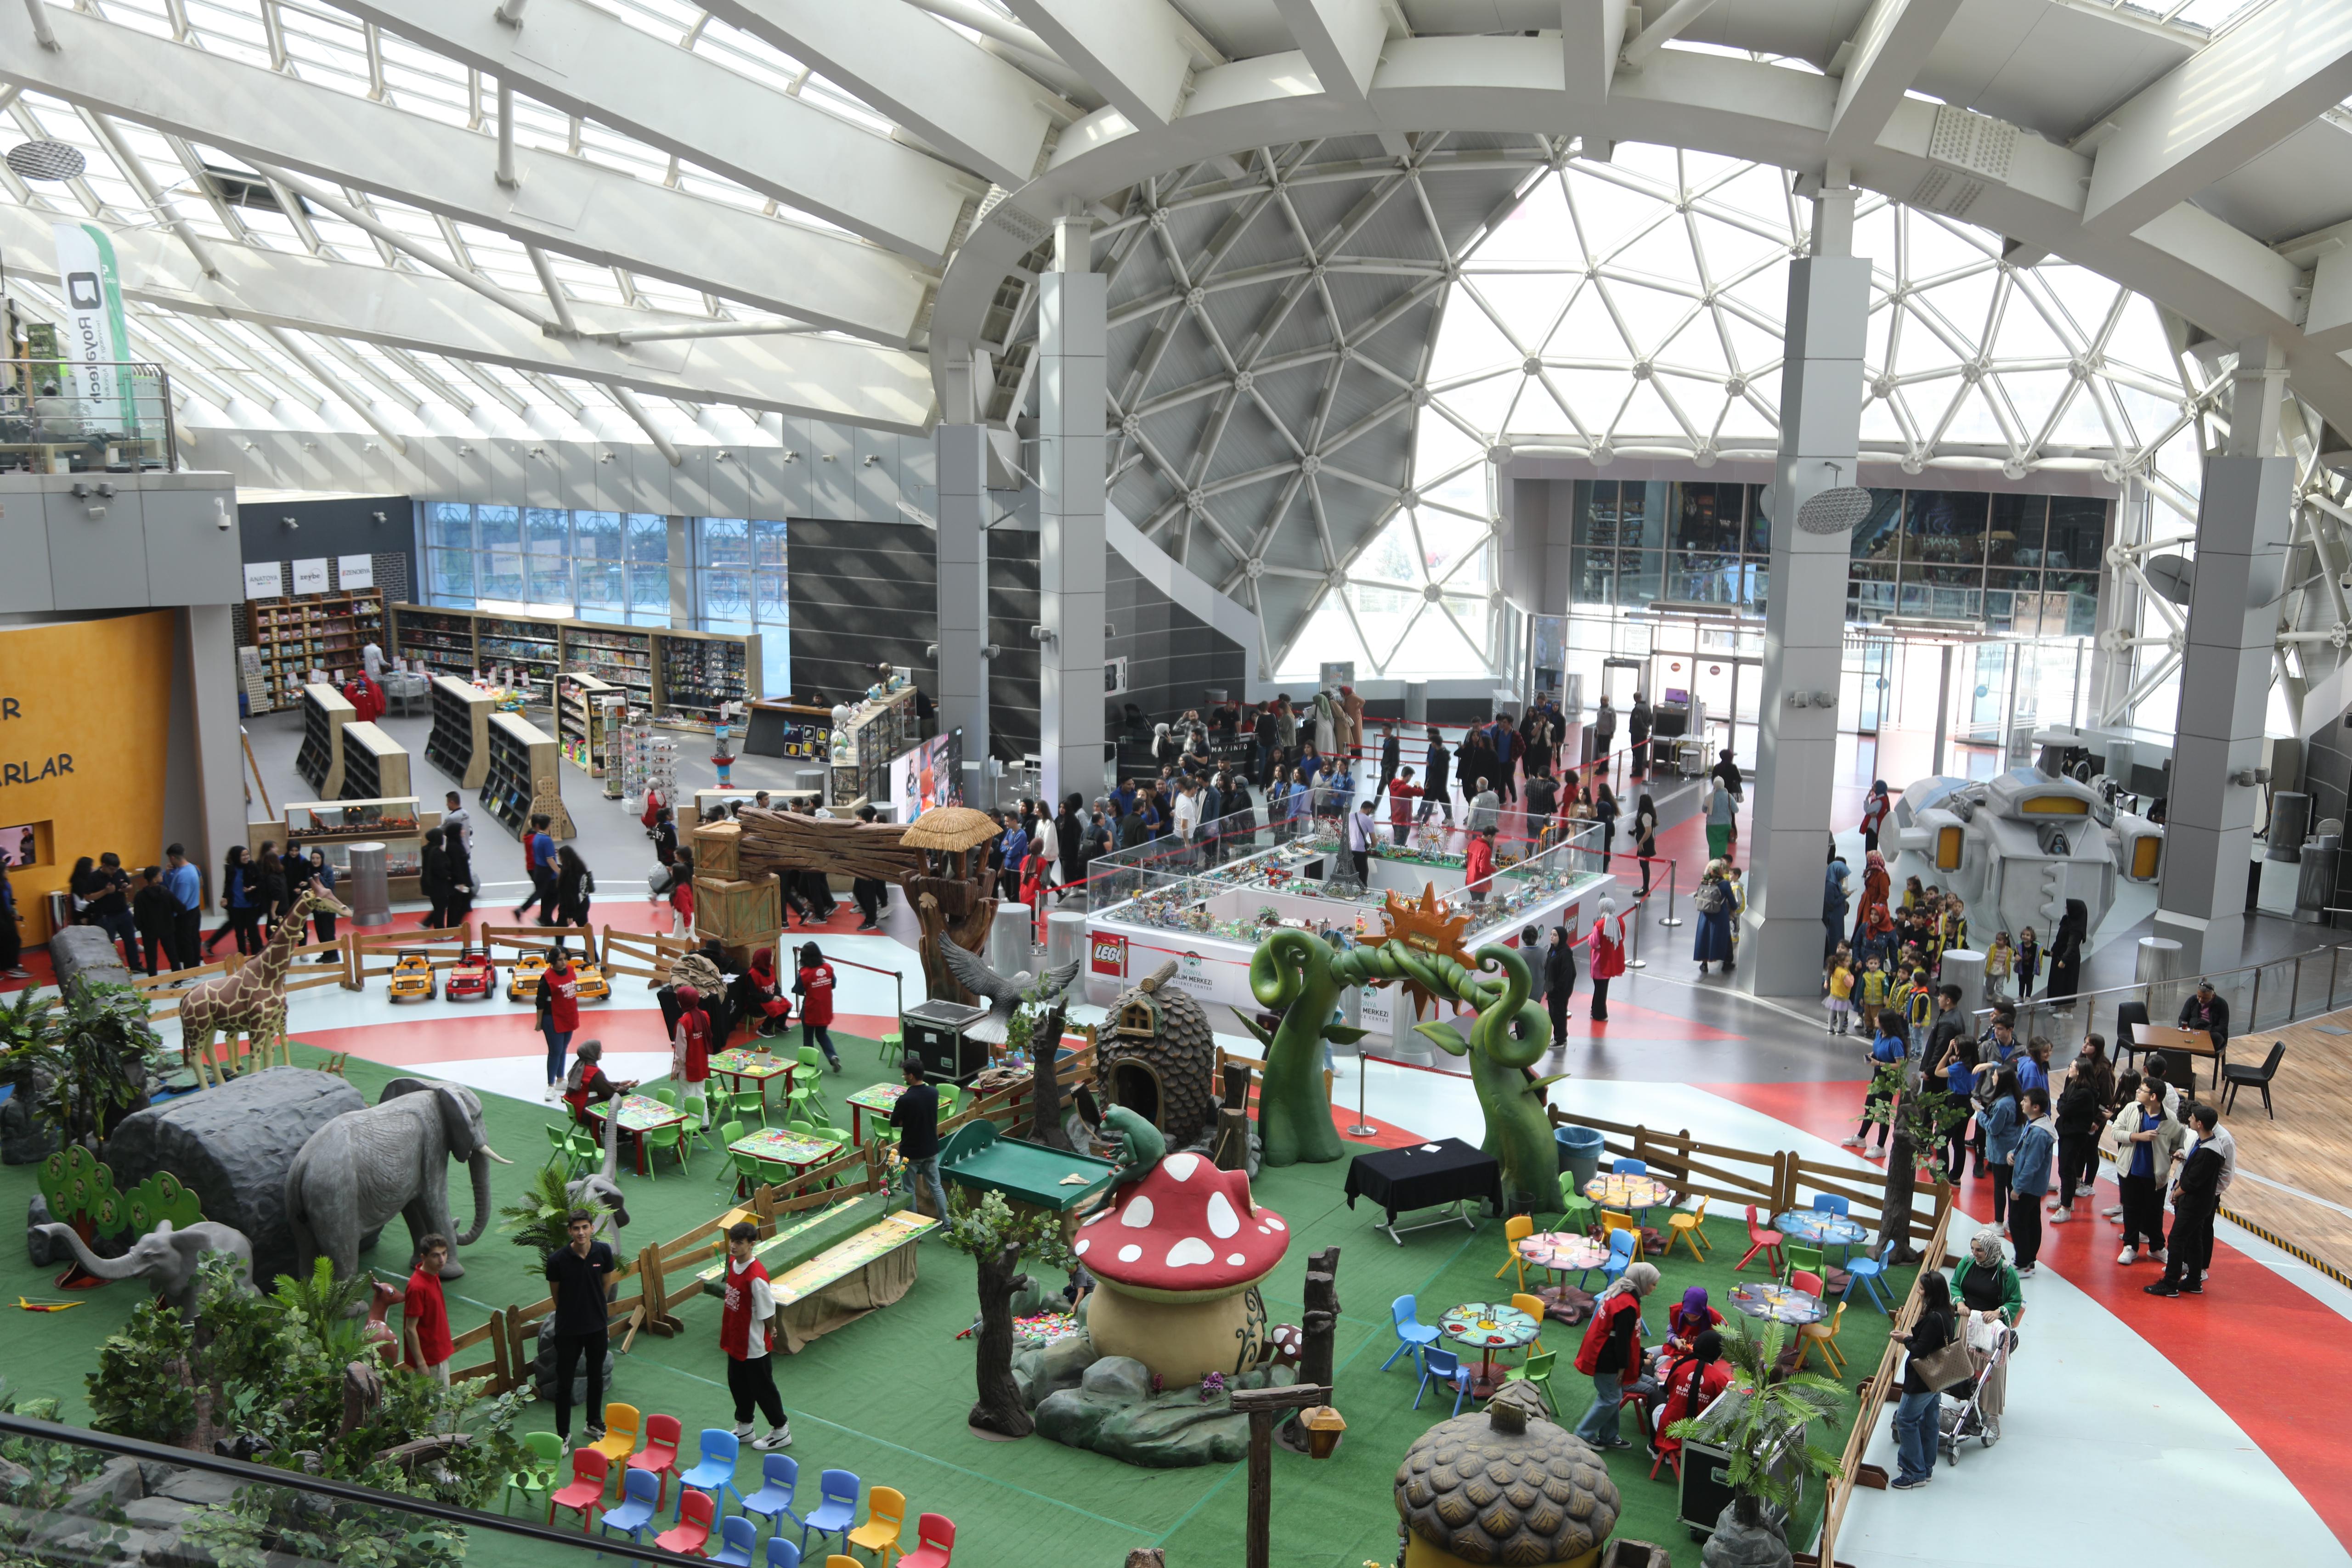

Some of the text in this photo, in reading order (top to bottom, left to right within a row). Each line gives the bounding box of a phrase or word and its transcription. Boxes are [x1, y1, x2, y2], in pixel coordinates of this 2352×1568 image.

[300, 573, 321, 581] zeybe
[0, 753, 74, 787] RLAR
[1183, 968, 1202, 977] KONYA
[1172, 980, 1193, 988] SCIENCE
[1189, 976, 1213, 986] MERKEZİ
[1361, 1000, 1377, 1008] ONYA
[1363, 1007, 1389, 1018] MERKEZİ
[1368, 1015, 1389, 1023] CENTER
